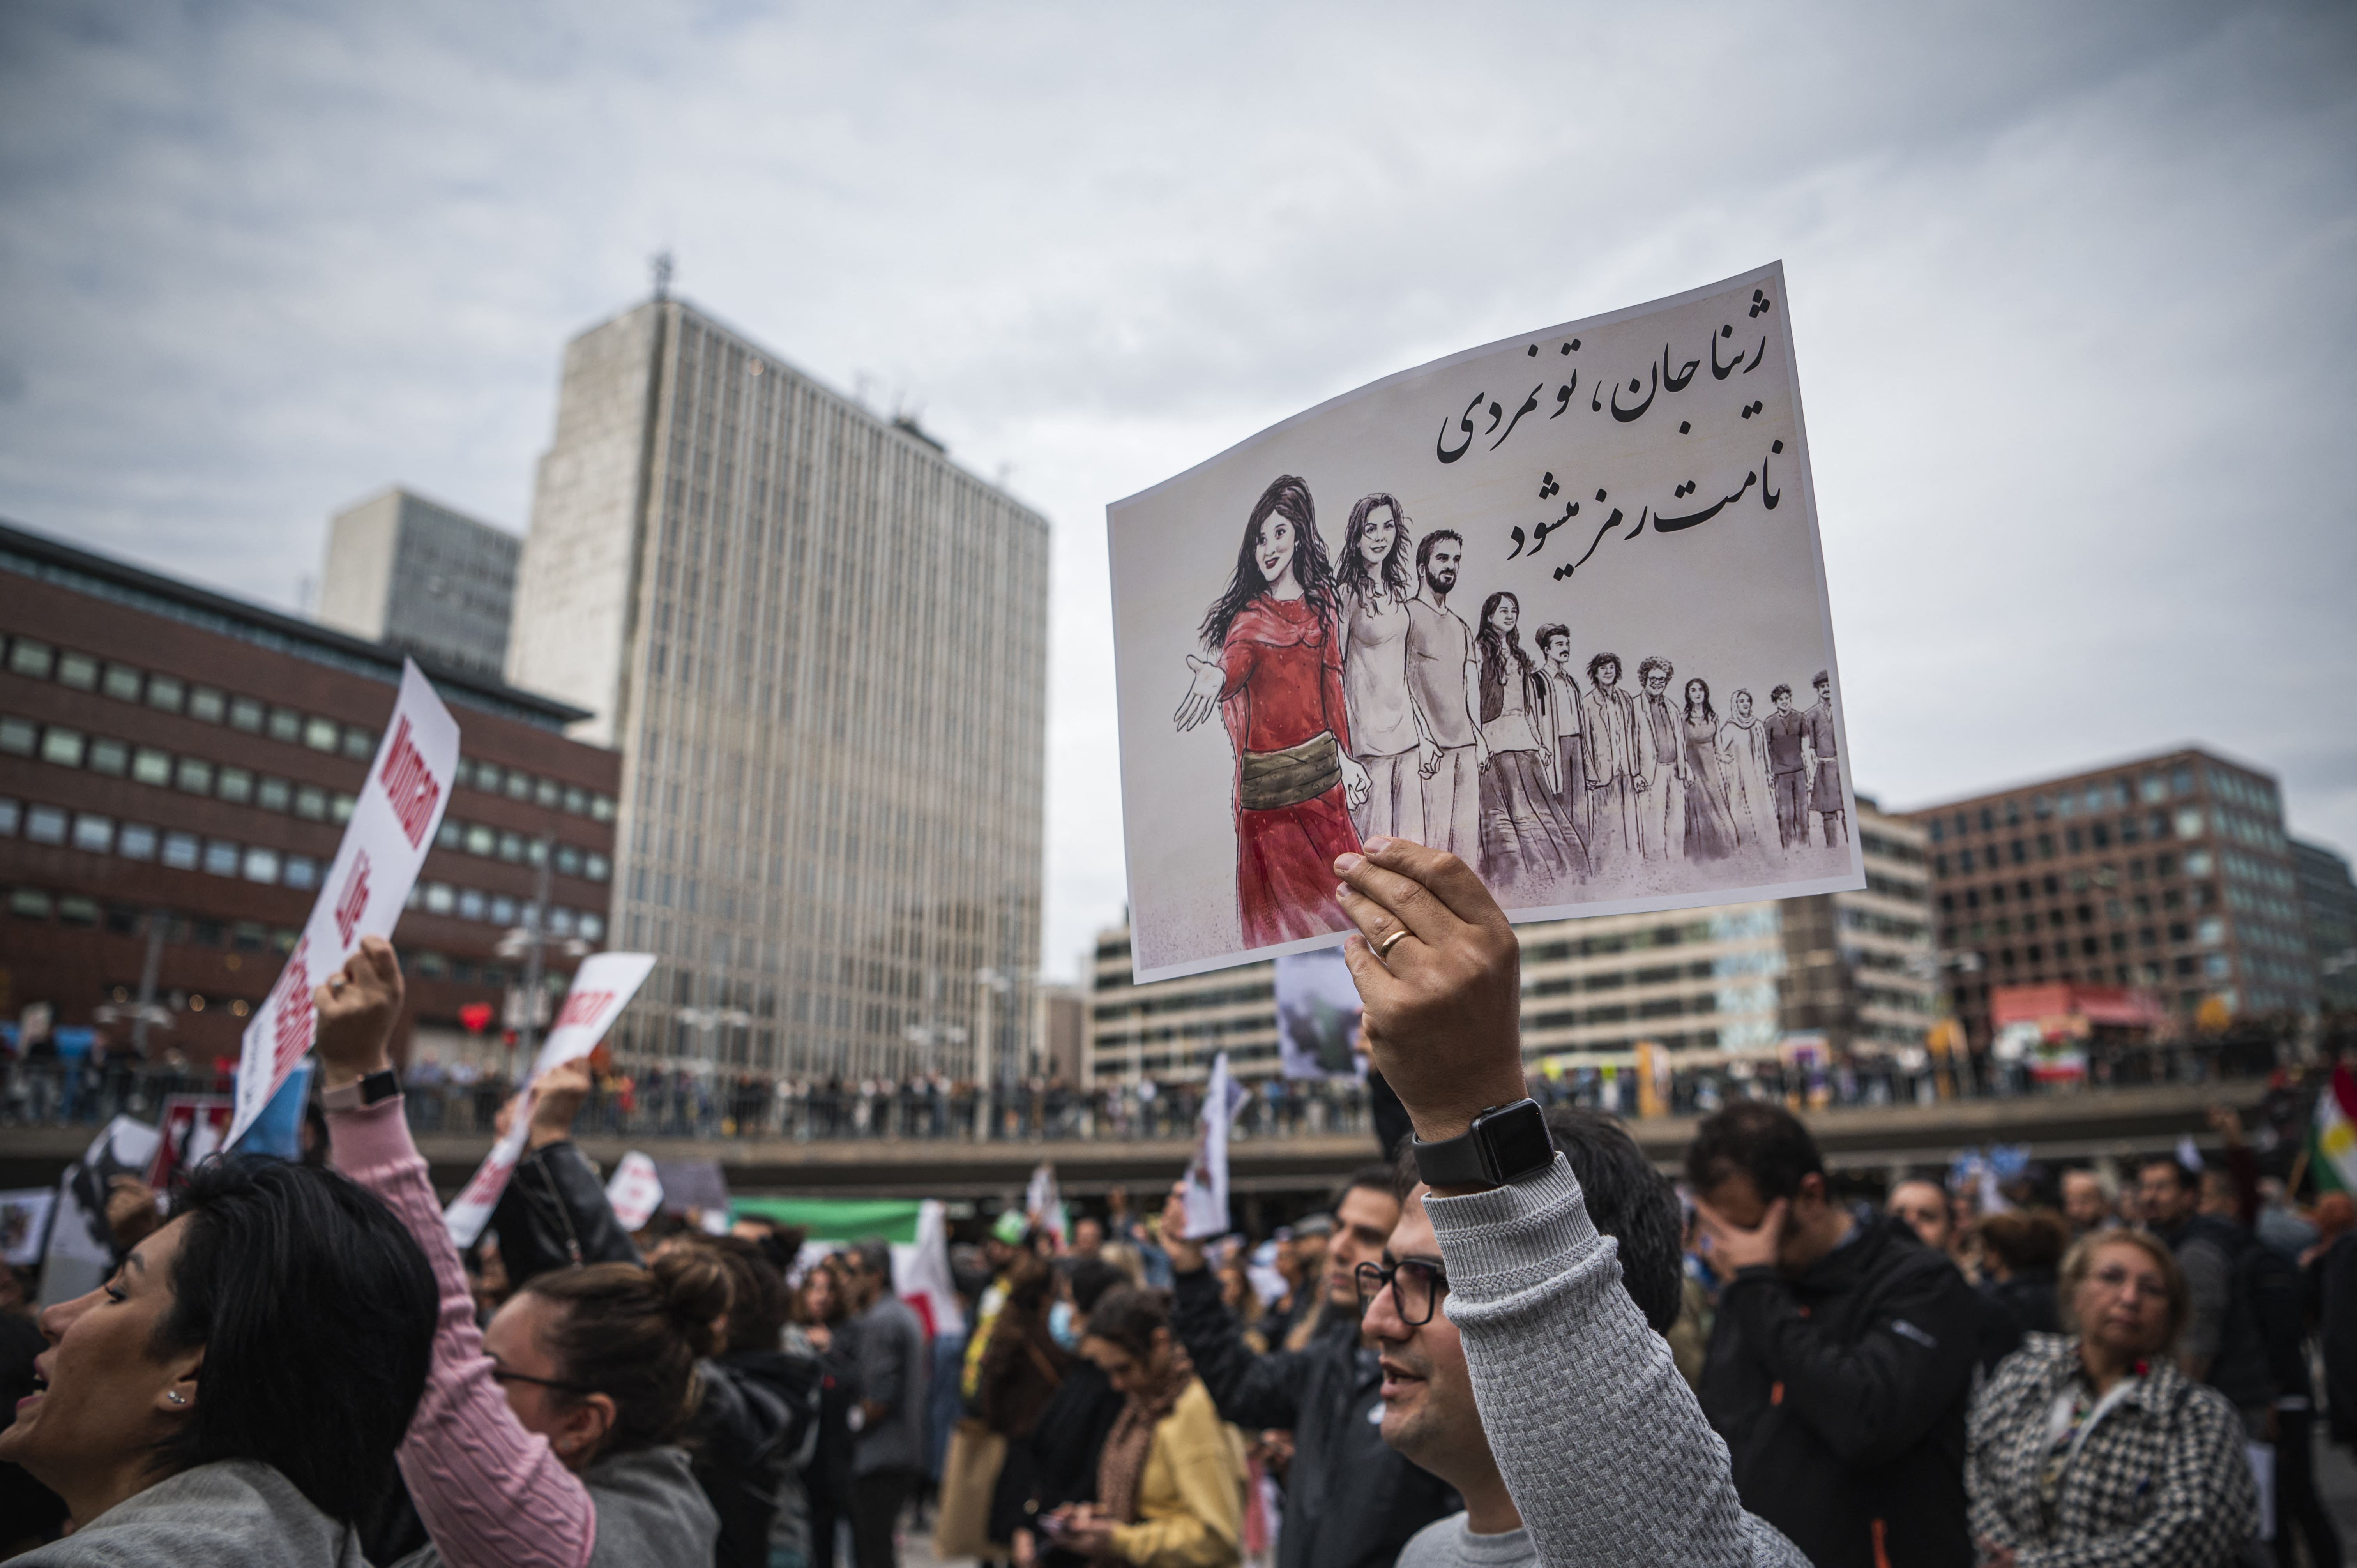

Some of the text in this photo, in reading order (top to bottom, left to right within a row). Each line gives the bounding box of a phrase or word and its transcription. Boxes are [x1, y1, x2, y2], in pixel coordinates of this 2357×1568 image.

[1549, 338, 1581, 420] تو
[1711, 288, 1771, 420] ژینا
[1436, 344, 1544, 464] نمردی
[1574, 488, 1648, 569] رمز
[1653, 439, 1784, 533] نامت
